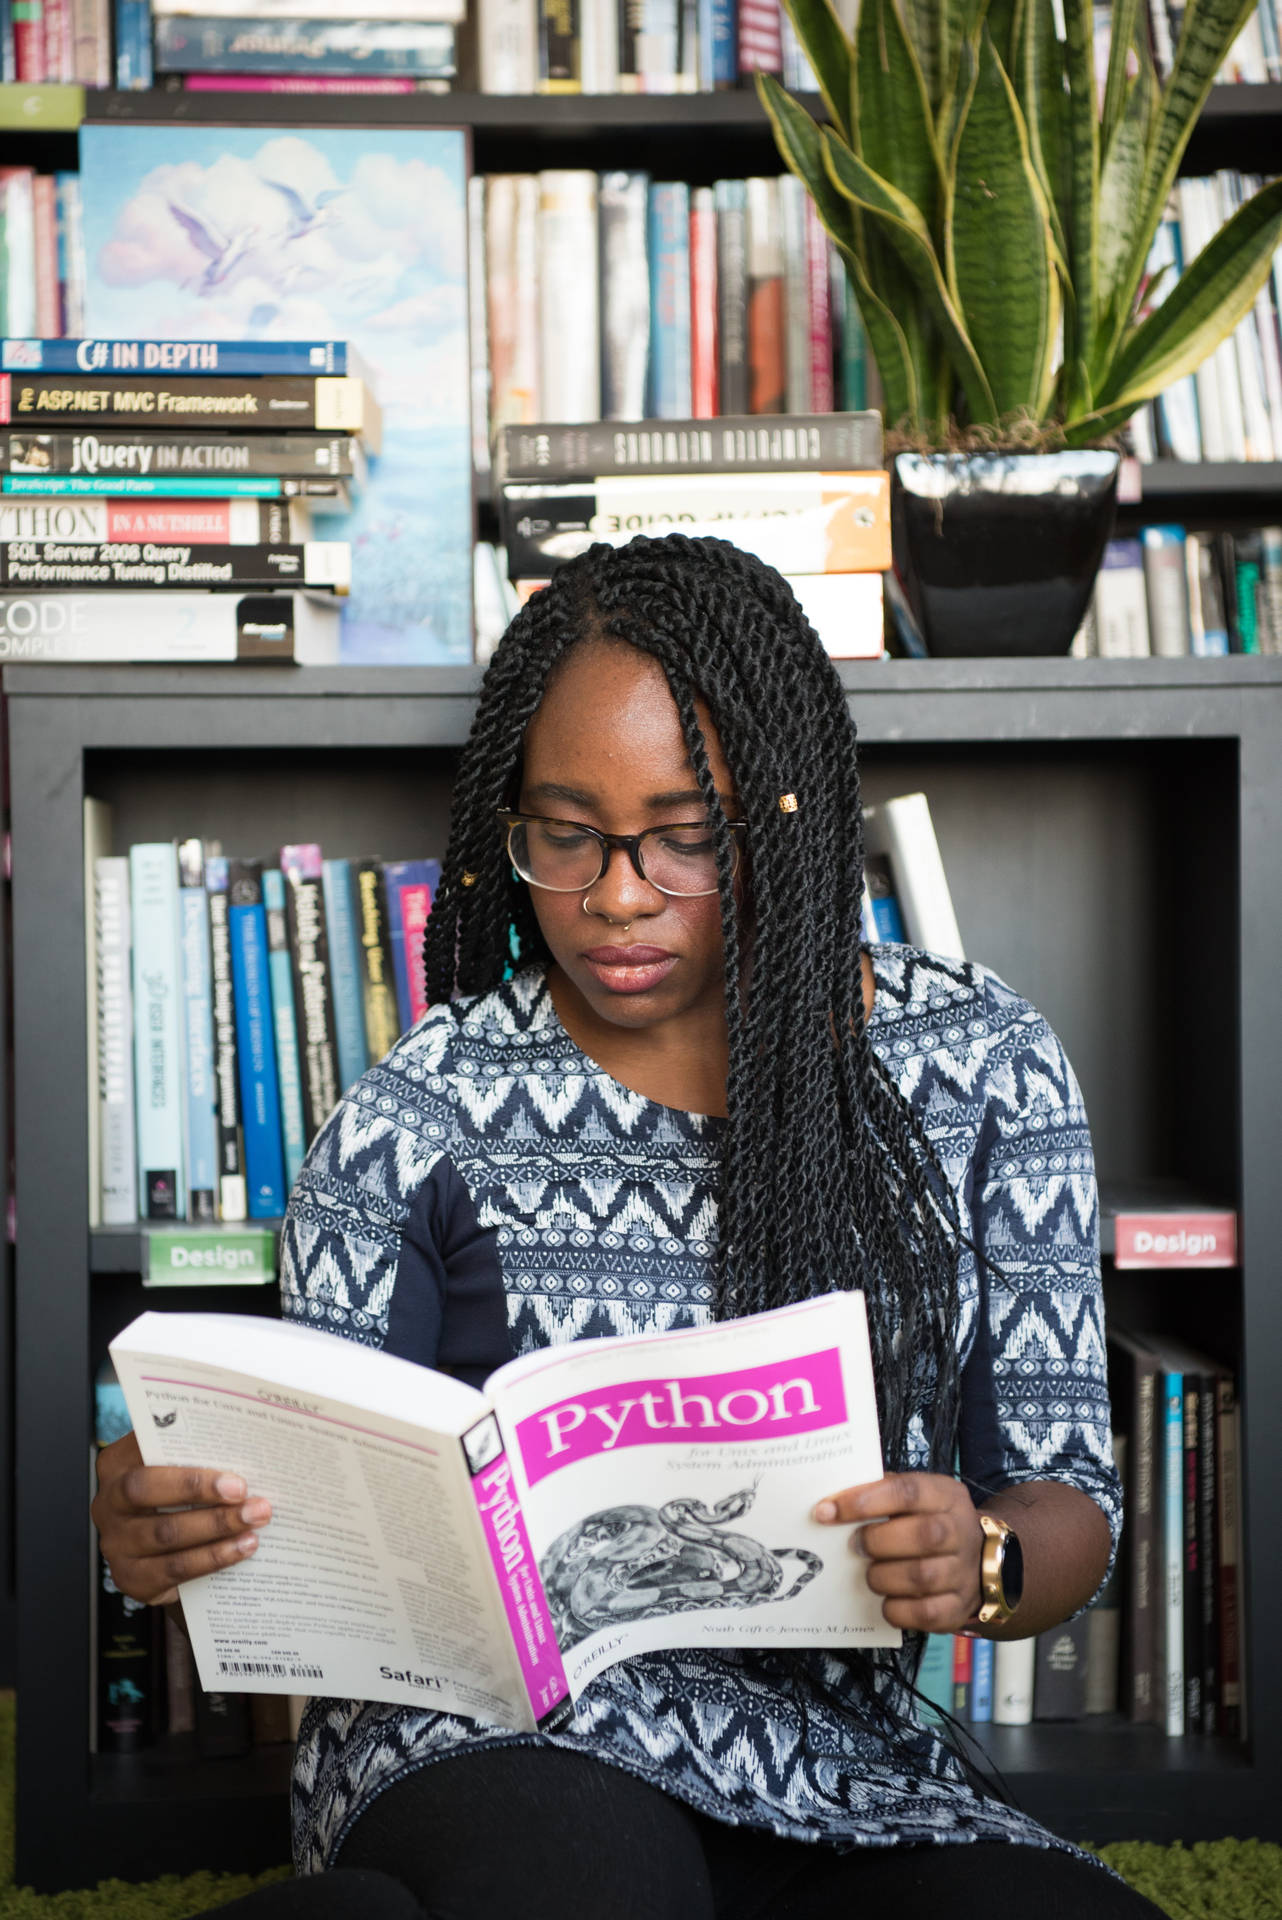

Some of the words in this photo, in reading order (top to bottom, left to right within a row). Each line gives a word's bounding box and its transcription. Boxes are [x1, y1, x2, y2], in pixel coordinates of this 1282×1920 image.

[76, 340, 109, 371] C#
[113, 344, 139, 369] IN
[144, 343, 218, 369] DEPTH
[36, 390, 111, 412] ASP.NET
[113, 391, 155, 412] MVC
[157, 392, 259, 414] Framework
[70, 436, 153, 473] jQuery
[156, 446, 176, 467] IN
[180, 446, 250, 468] ACTION
[8, 543, 38, 561] SQL
[43, 543, 97, 561] Server
[143, 543, 191, 566] Query
[8, 563, 110, 581] Performance
[113, 563, 165, 584] Tuning
[168, 563, 232, 581] Distilled
[0, 600, 88, 634] ODE
[182, 895, 205, 995] Designing
[186, 999, 207, 1097] Interfaces
[170, 1245, 255, 1271] Design
[1133, 1230, 1217, 1257] Design
[539, 1373, 821, 1458] Python
[665, 1459, 722, 1471] System
[729, 1446, 854, 1470] Administration
[689, 1447, 711, 1460] for
[719, 1446, 759, 1458] Unix
[764, 1439, 799, 1455] and
[804, 1431, 851, 1450] Linux
[479, 1461, 525, 1574] Python
[516, 1604, 540, 1667] Administration
[739, 1624, 763, 1634] Gift
[779, 1625, 822, 1634] Jeremy
[841, 1625, 876, 1634] Jones
[572, 1635, 626, 1680] O'REILLY
[380, 1665, 442, 1690] Safari
